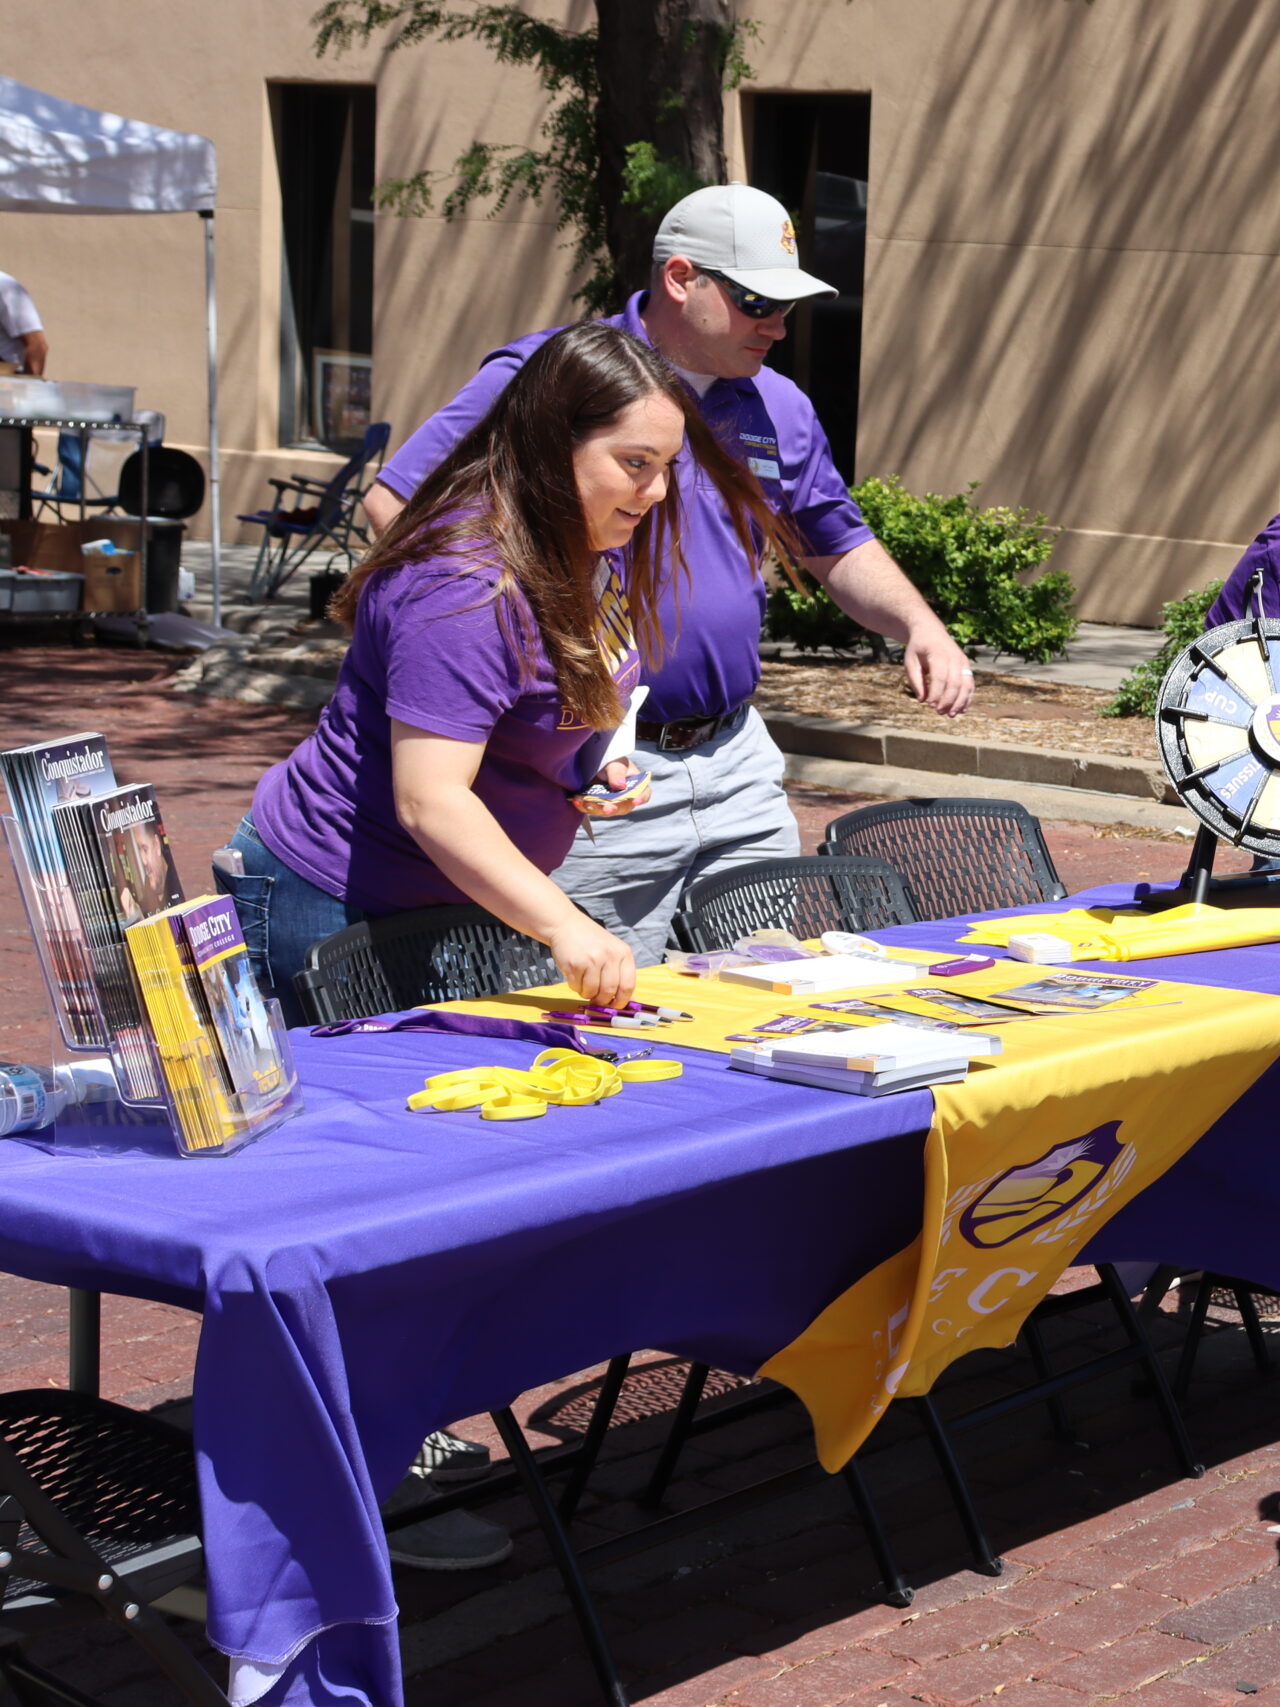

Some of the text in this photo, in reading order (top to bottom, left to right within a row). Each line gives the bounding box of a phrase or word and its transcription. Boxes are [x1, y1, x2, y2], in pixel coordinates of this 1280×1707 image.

[1204, 691, 1238, 714] CUP
[41, 745, 104, 783] Conquistador
[1220, 759, 1263, 800] TISSUES
[100, 795, 154, 834] Conquistador
[207, 911, 232, 937] CITY
